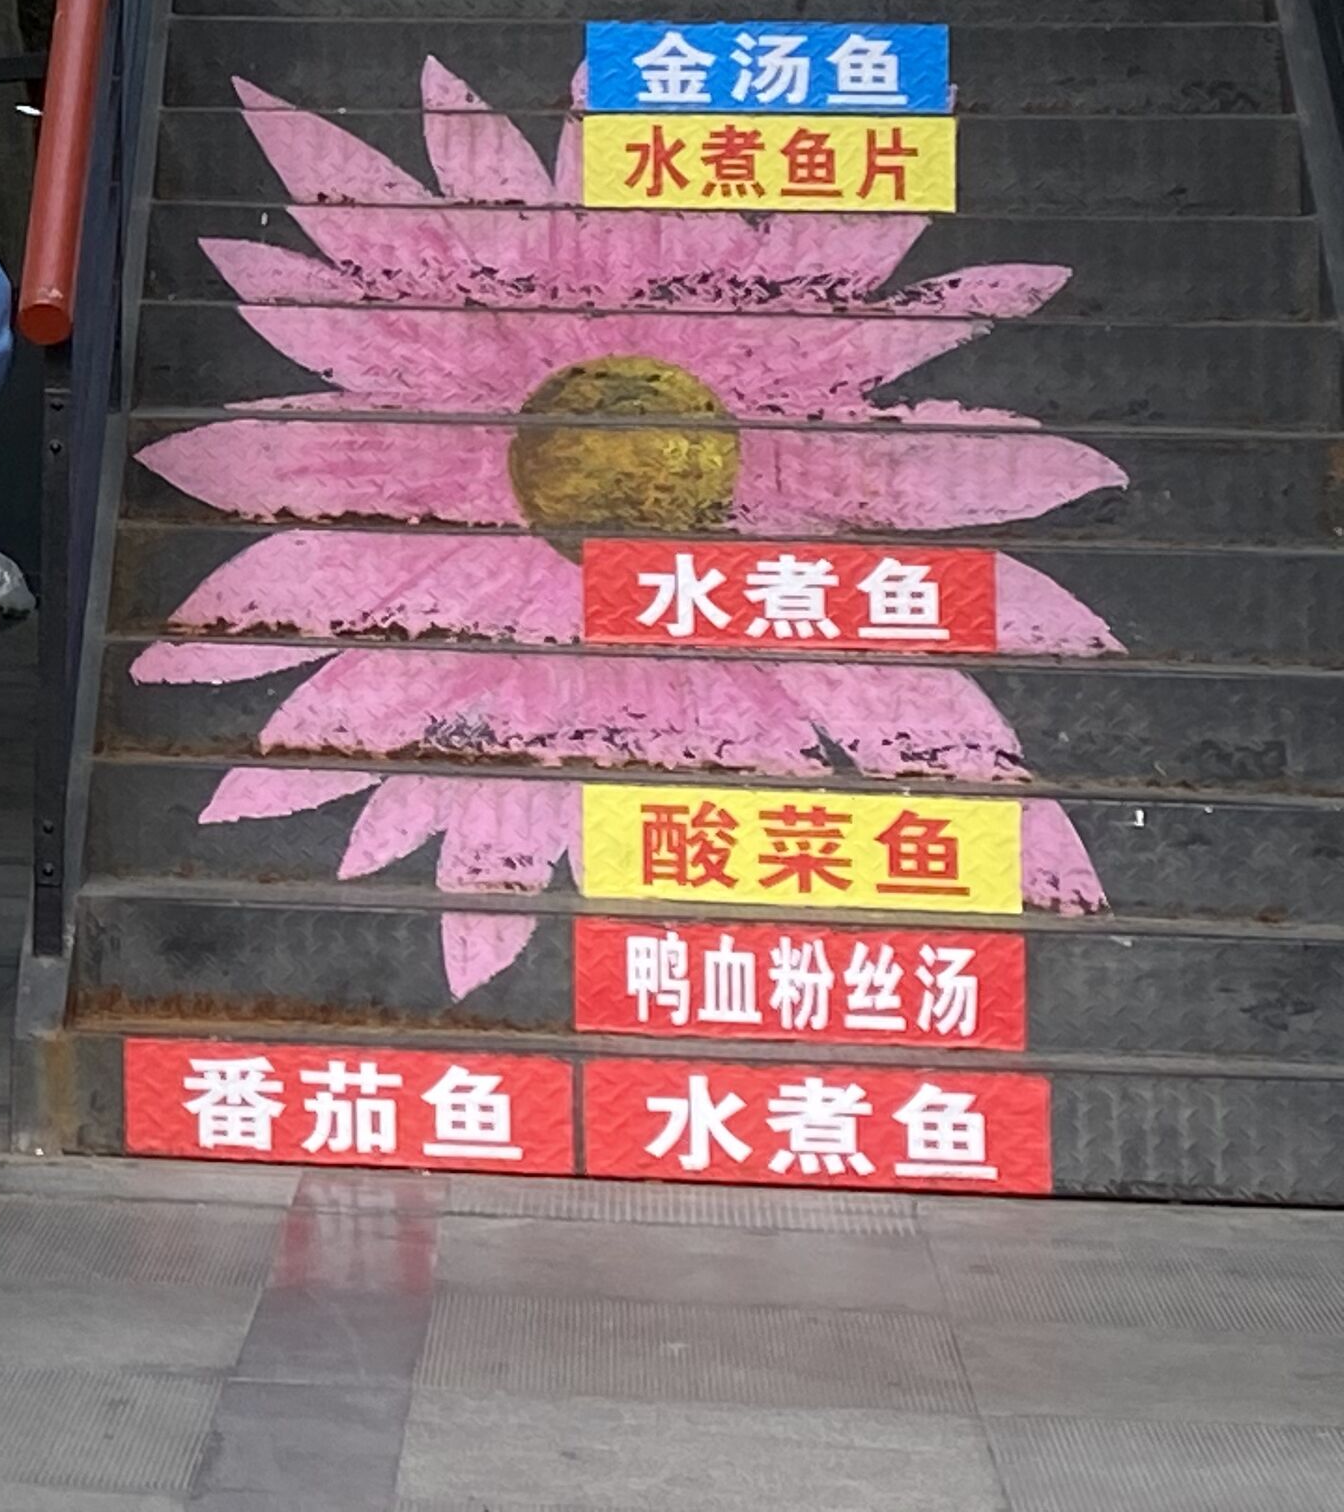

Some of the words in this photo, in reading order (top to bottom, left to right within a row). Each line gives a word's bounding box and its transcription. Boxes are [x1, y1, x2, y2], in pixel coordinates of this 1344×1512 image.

[632, 30, 909, 106] 金汤鱼
[624, 124, 919, 201] 水煮鱼片
[636, 553, 951, 640] 水煮鱼
[640, 801, 971, 896] 酸菜鱼
[625, 931, 979, 1037] 鸭血粉丝汤
[182, 1055, 524, 1161] 番茄鱼
[643, 1075, 999, 1180] 水煮鱼
